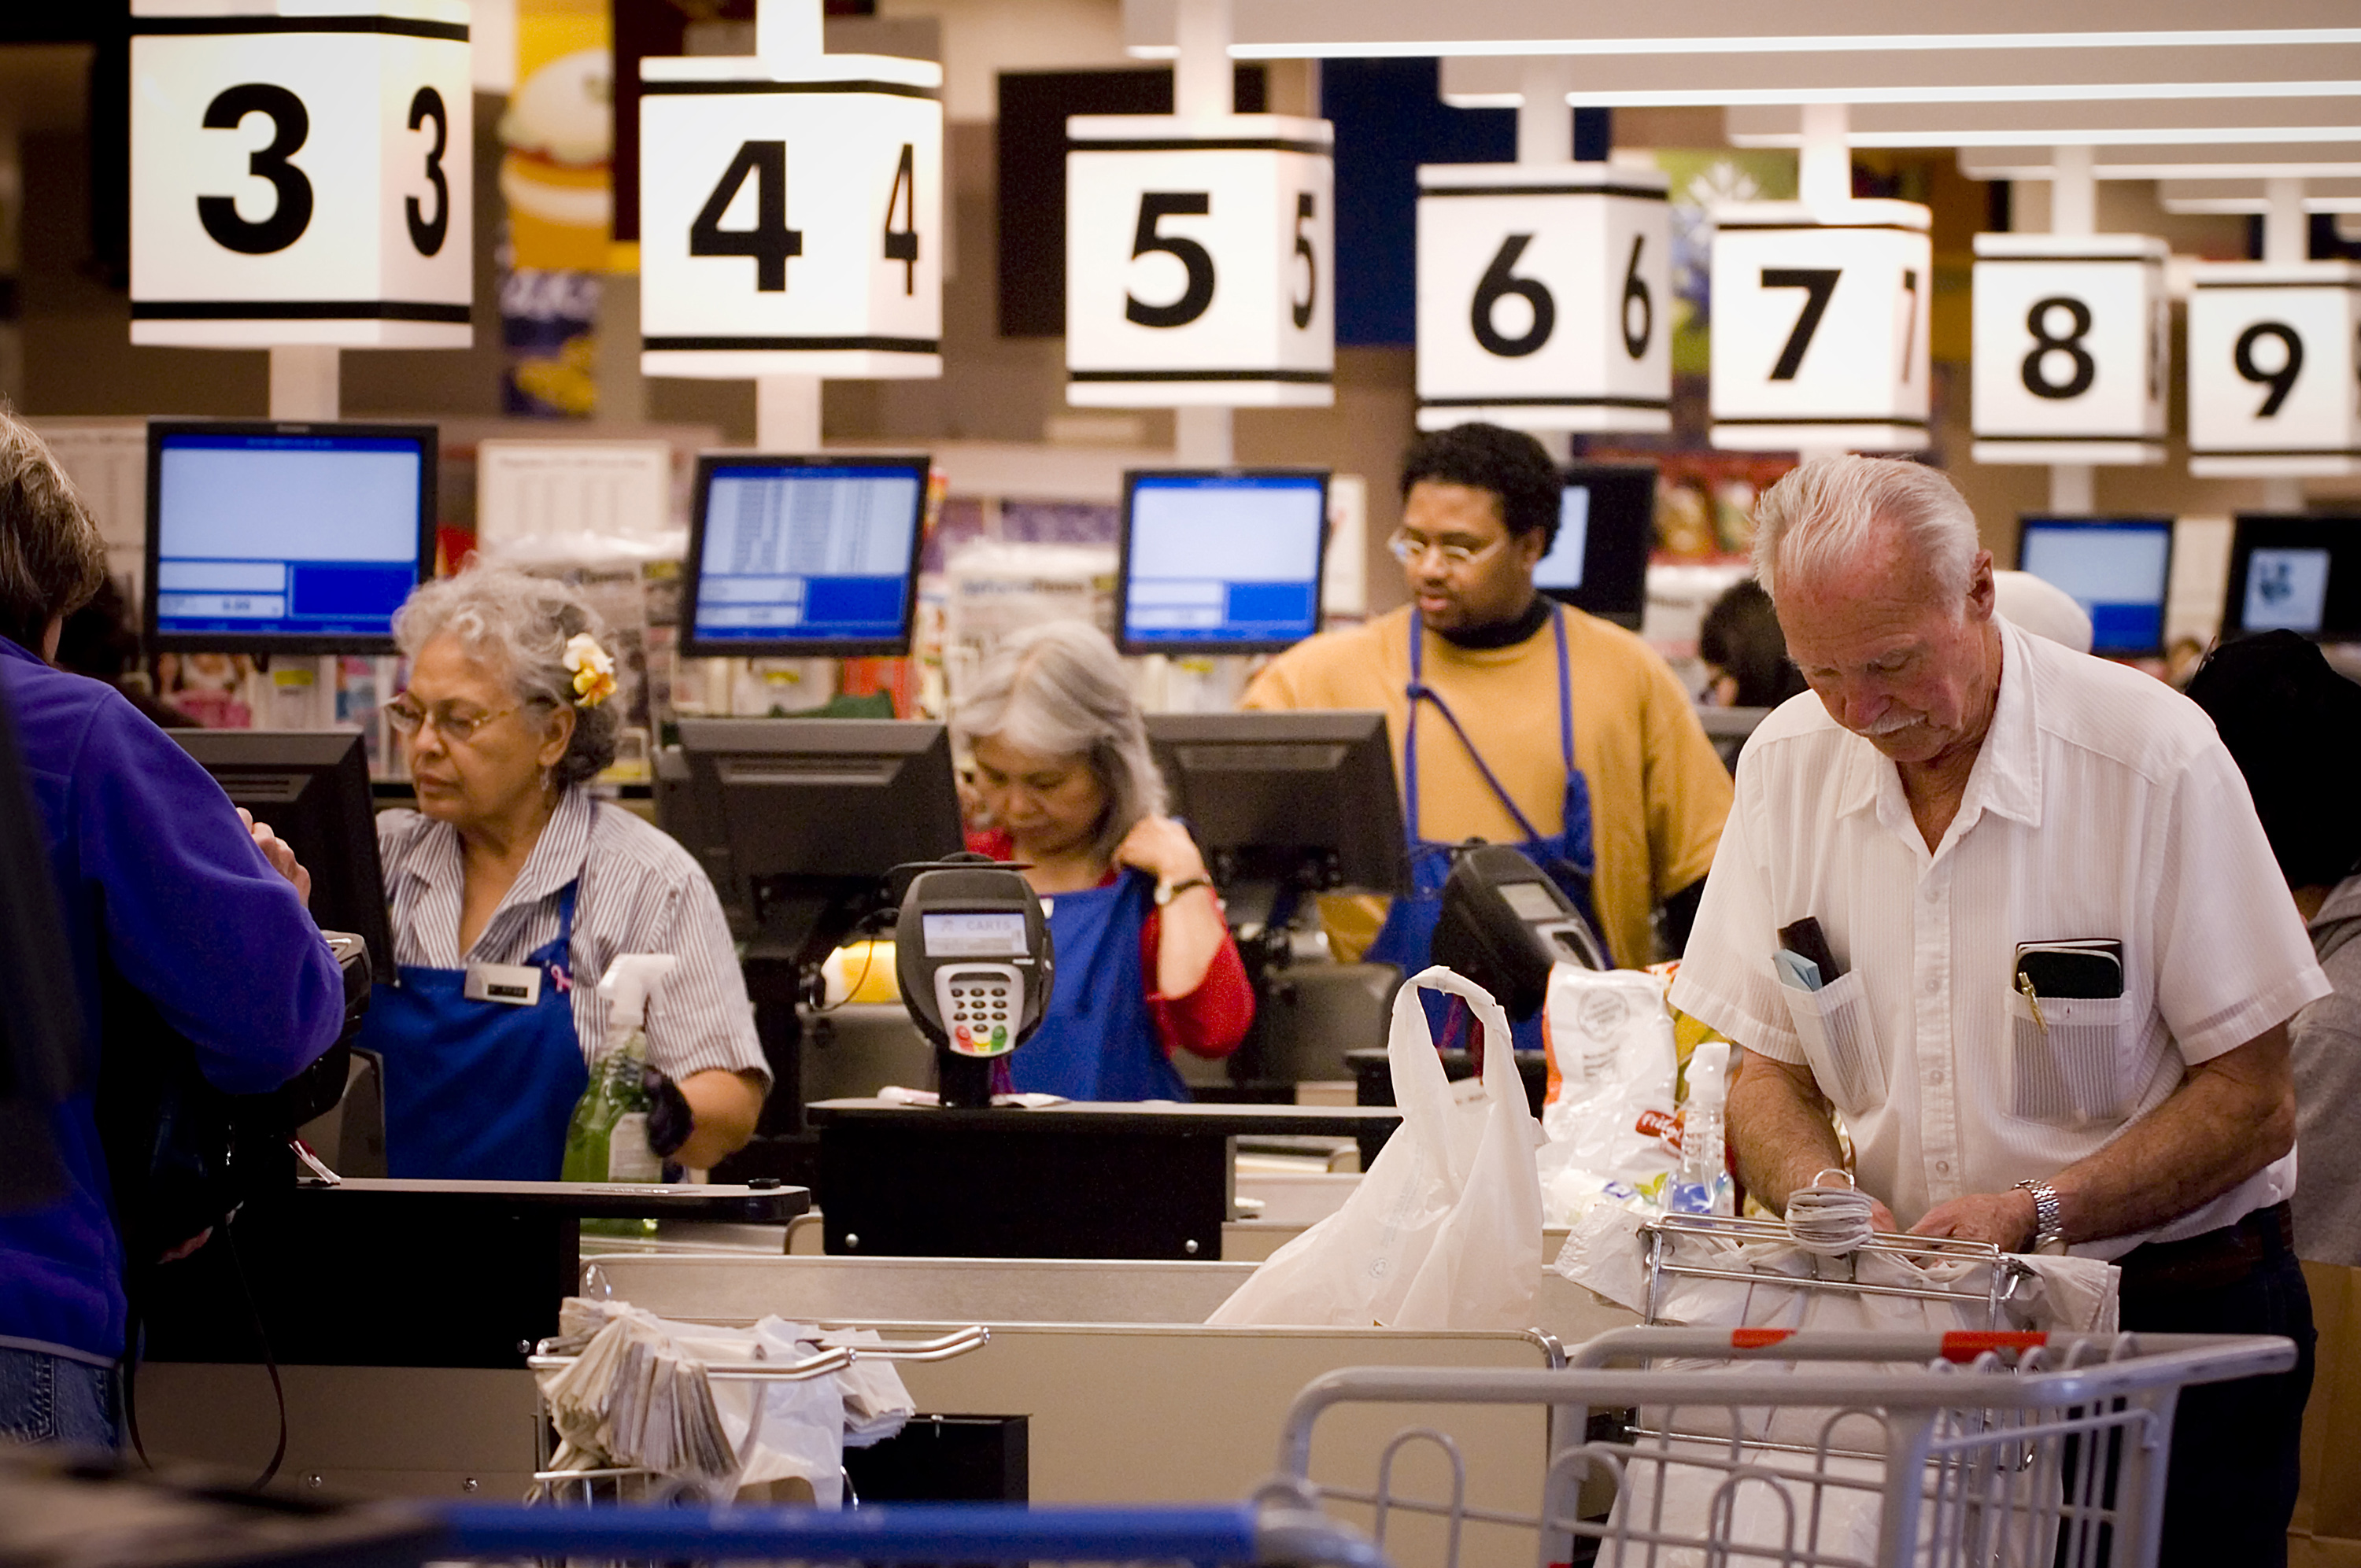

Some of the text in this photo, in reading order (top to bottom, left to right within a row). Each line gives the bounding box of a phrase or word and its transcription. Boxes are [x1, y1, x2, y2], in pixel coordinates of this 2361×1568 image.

[197, 83, 314, 256] 3
[405, 86, 449, 258] 3
[689, 140, 803, 292] 4
[884, 144, 918, 296] 4
[1125, 192, 1215, 329] 5
[1292, 192, 1316, 330] 5
[1470, 234, 1556, 358] 6
[1621, 234, 1653, 360] 6
[1761, 268, 1842, 381] 7
[1903, 270, 1917, 383] 7
[2021, 296, 2096, 400] 8
[2234, 321, 2304, 419] 9
